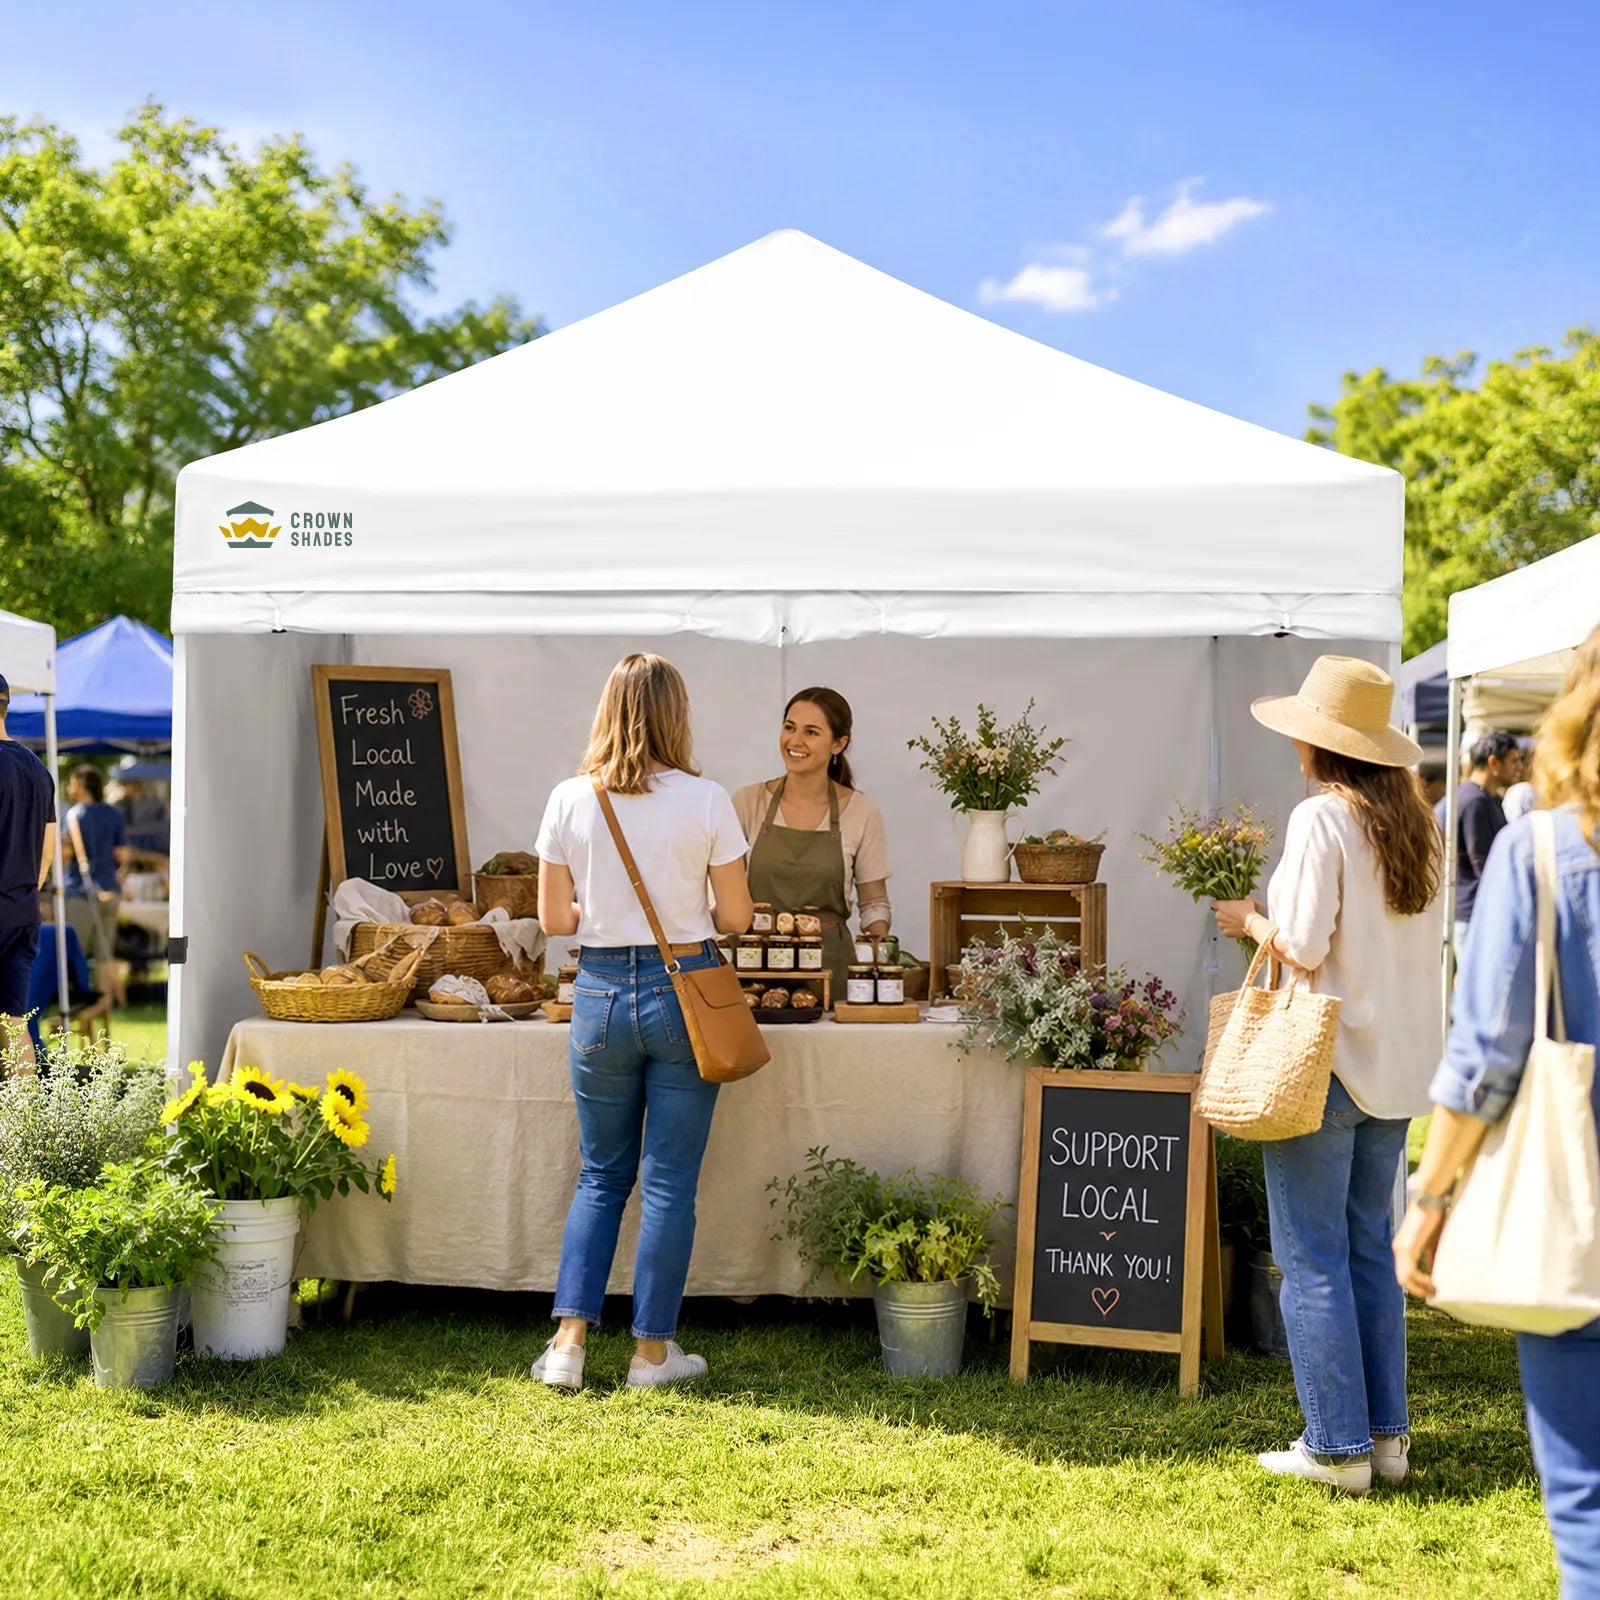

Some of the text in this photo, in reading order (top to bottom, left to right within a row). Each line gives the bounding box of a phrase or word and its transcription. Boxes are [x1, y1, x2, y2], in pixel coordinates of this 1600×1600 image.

[291, 512, 353, 529] CROWN
[291, 531, 353, 547] SHADES
[340, 693, 405, 725] Fresh
[351, 738, 416, 766] Local
[355, 779, 417, 807] Made
[357, 818, 409, 844] with
[369, 852, 424, 880] Love
[1049, 1127, 1180, 1172] SUPPORT
[1062, 1182, 1159, 1224] LOCAL
[1045, 1248, 1171, 1283] THANK YOU!
